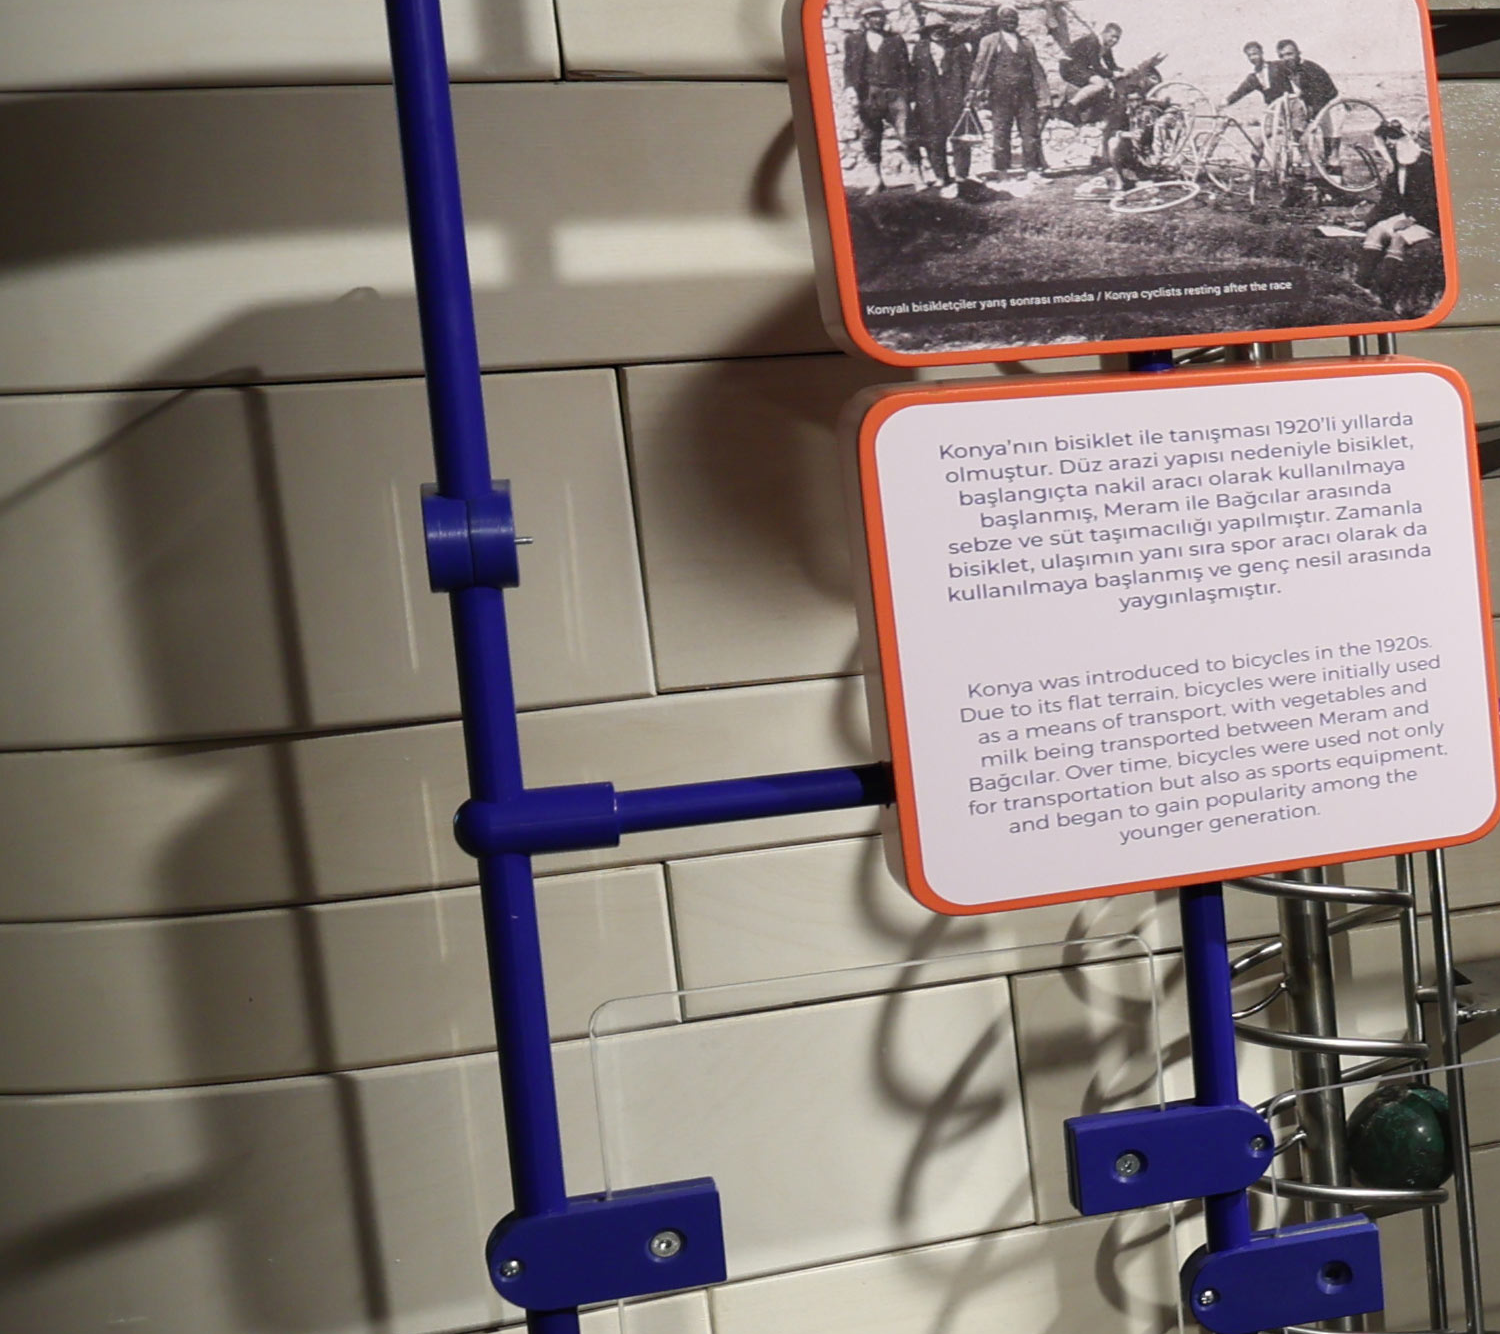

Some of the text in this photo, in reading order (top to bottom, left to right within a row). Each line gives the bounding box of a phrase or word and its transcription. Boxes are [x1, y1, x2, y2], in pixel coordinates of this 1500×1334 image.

[865, 301, 910, 317] Konyalı
[910, 297, 977, 313] bisikletçiler
[977, 297, 1008, 311] yarış
[1008, 295, 1051, 307] sonrası
[1051, 290, 1095, 304] molada
[1103, 289, 1139, 302] Konya
[1138, 285, 1183, 301] cyclists
[1182, 282, 1222, 297] resting
[1221, 281, 1248, 294] after
[1248, 280, 1268, 292] the
[1267, 280, 1293, 291] race
[938, 410, 1414, 461] Konya'nın bisiklet ile tanışması 1920'li yıllarda
[966, 634, 1432, 699] Konya was introduced to bicycles in the 1920s.
